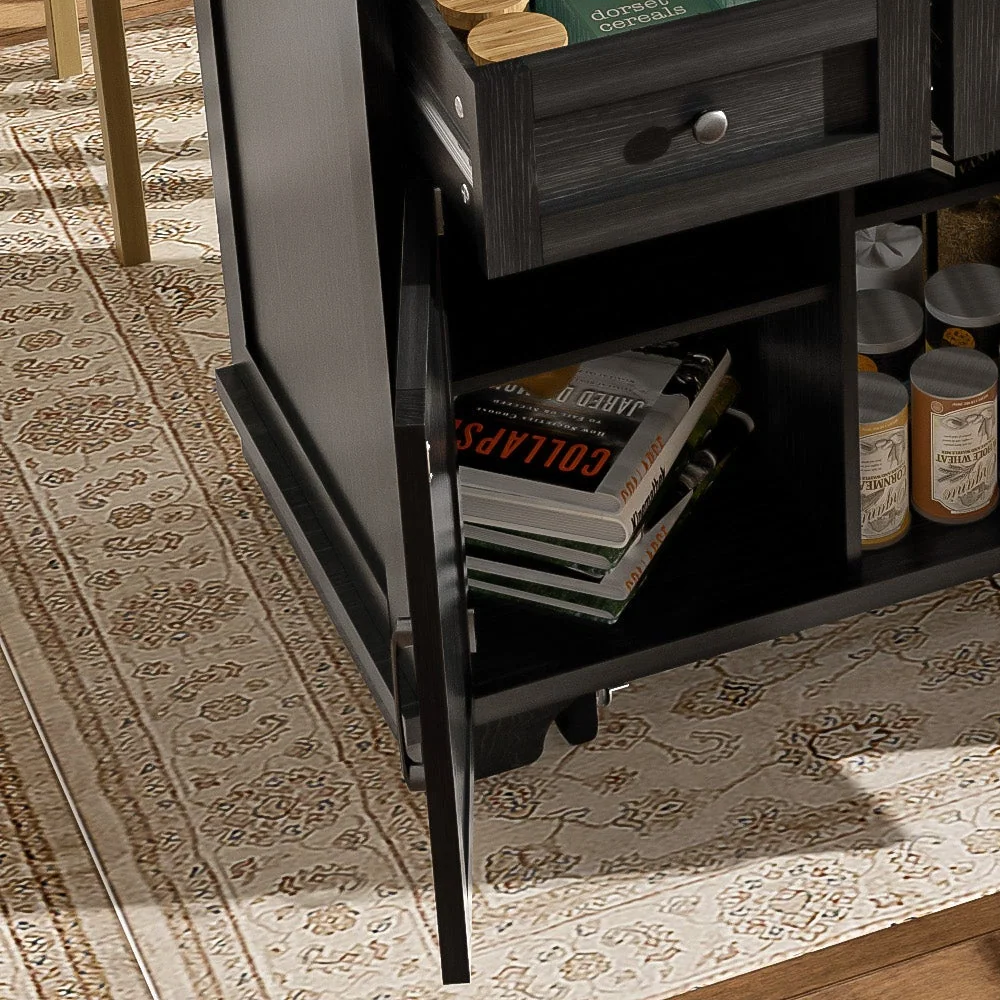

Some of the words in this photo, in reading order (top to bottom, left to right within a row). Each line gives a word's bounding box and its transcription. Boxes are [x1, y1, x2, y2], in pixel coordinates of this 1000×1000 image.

[599, 5, 687, 32] cereals
[576, 390, 645, 417] JARED
[935, 453, 972, 464] WHEAT
[860, 464, 907, 491] CORNMEA
